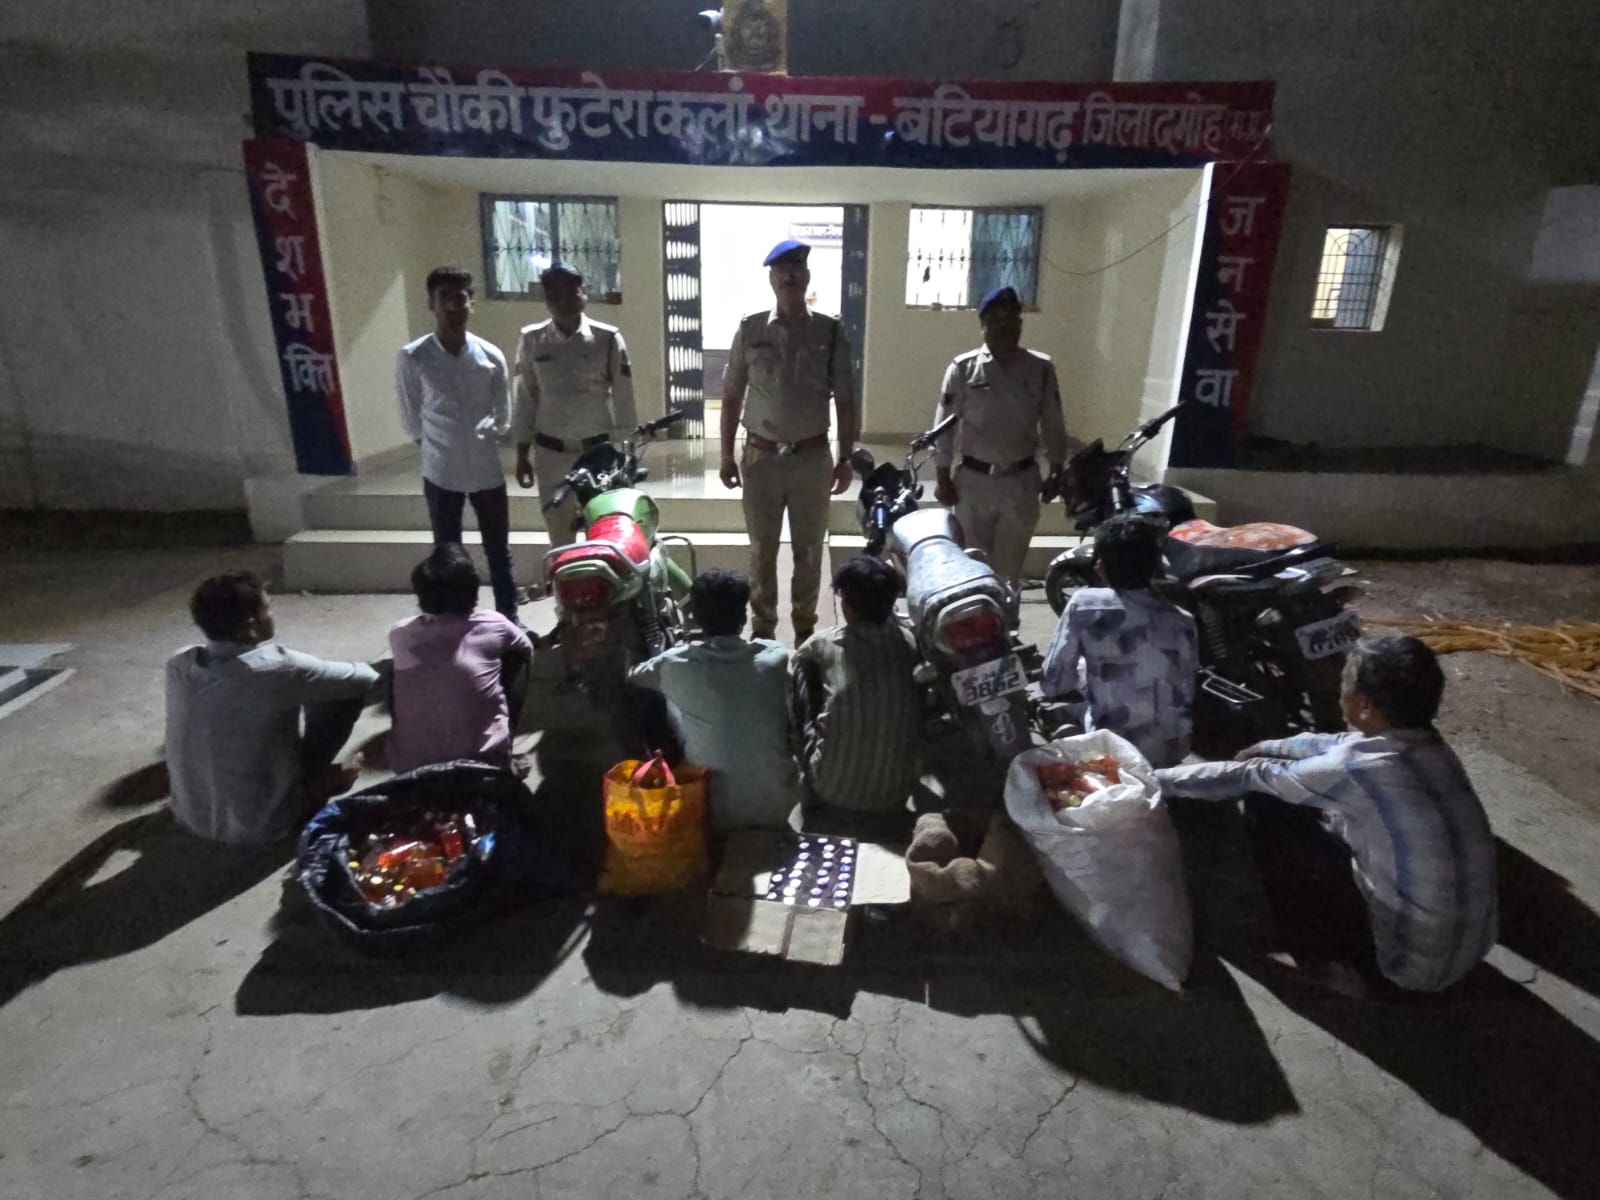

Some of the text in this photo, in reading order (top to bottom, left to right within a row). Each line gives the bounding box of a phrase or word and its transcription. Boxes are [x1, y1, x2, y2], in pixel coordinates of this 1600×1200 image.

[265, 62, 406, 139] पुलिस
[408, 66, 526, 134] चौकी
[528, 71, 651, 150] फुटेरा
[653, 76, 755, 144] कलां
[765, 93, 864, 144] थाना
